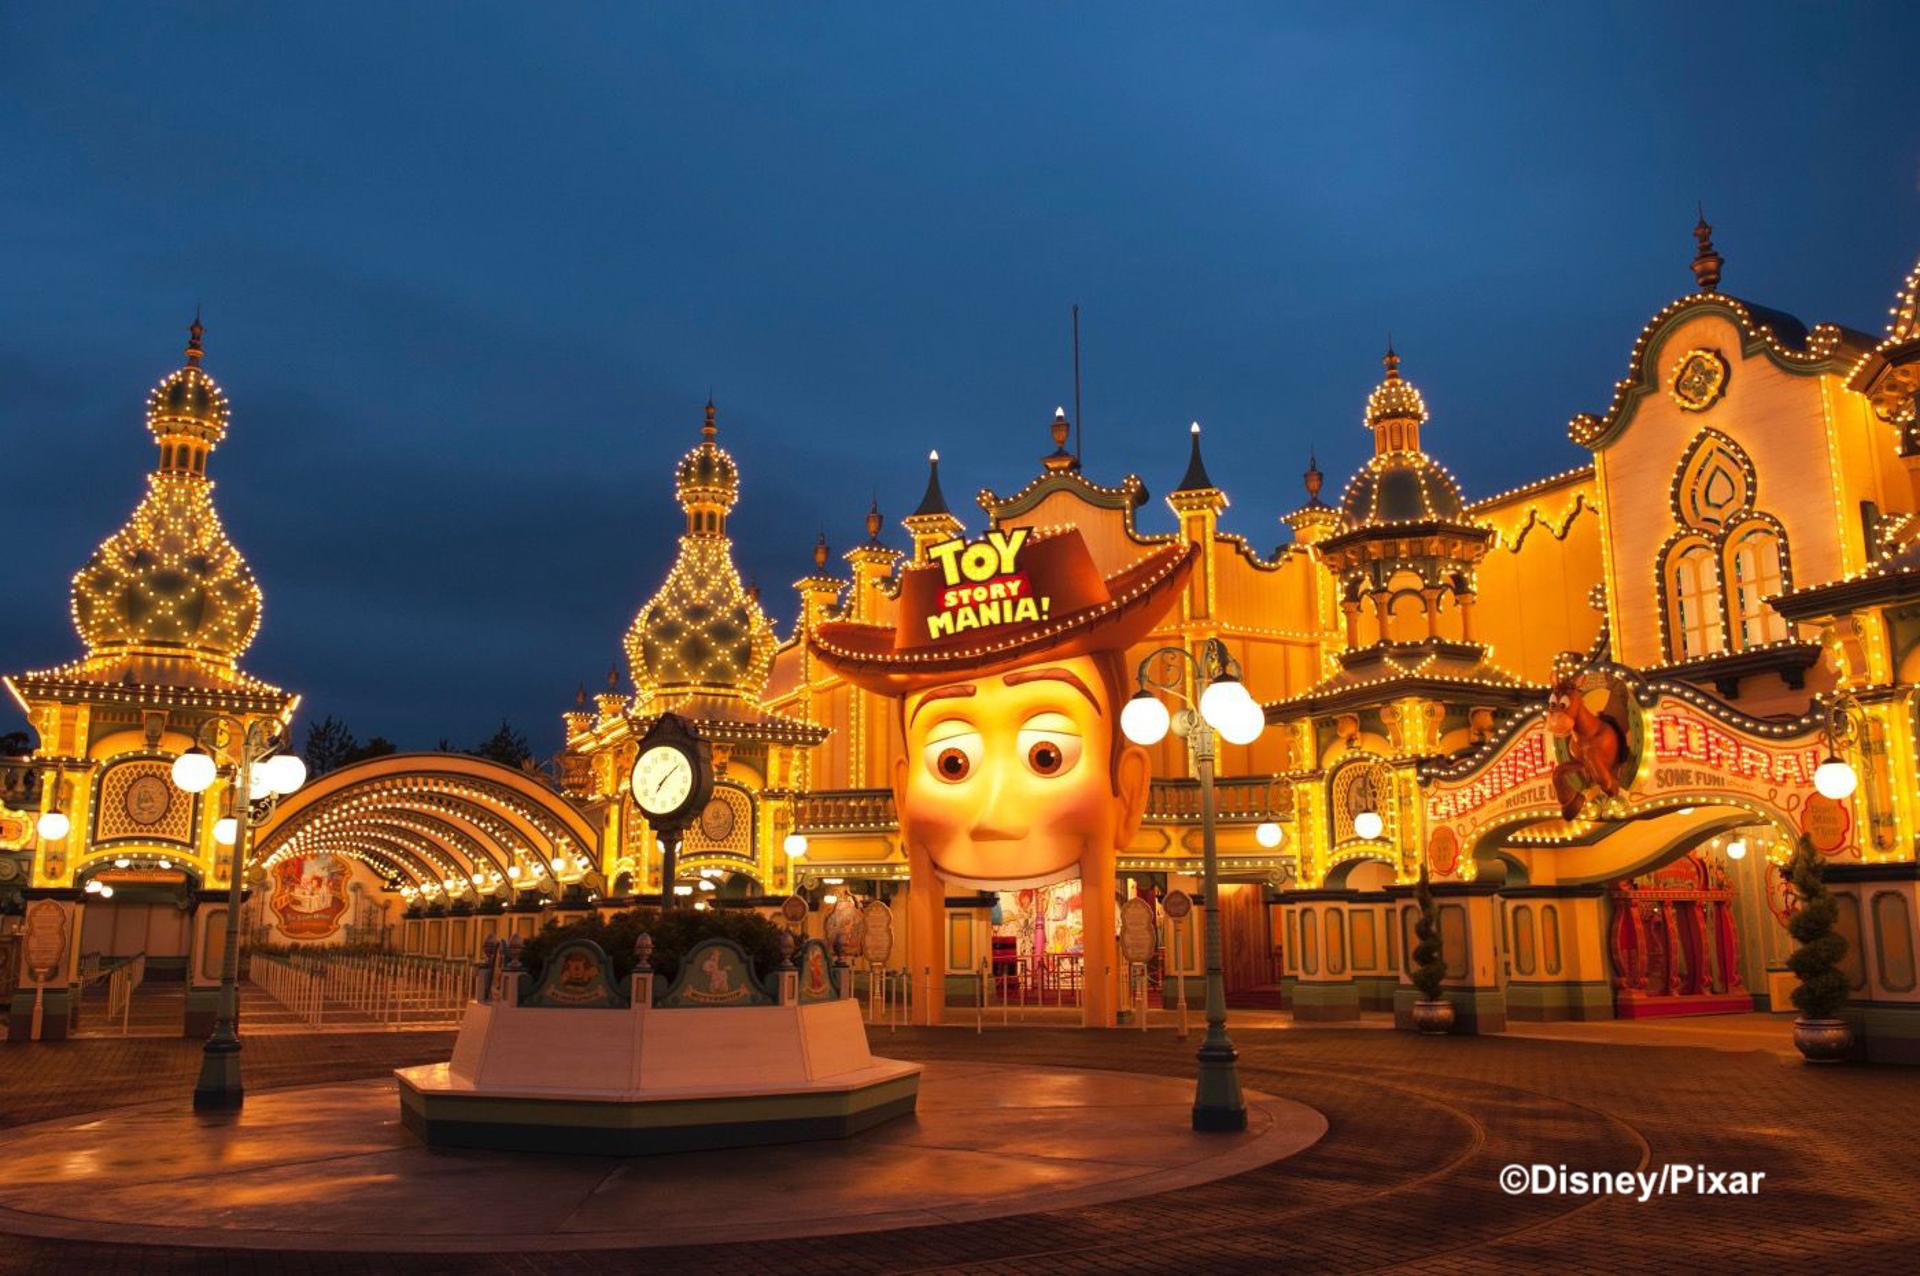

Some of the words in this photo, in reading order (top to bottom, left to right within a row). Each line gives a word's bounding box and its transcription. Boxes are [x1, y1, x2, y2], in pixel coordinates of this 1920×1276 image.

[928, 529, 1028, 586] TOY
[944, 580, 1021, 607] STORY
[927, 597, 1050, 640] MANIA!
[1427, 733, 1555, 821] CARNIVAL
[1655, 768, 1693, 788] SOME
